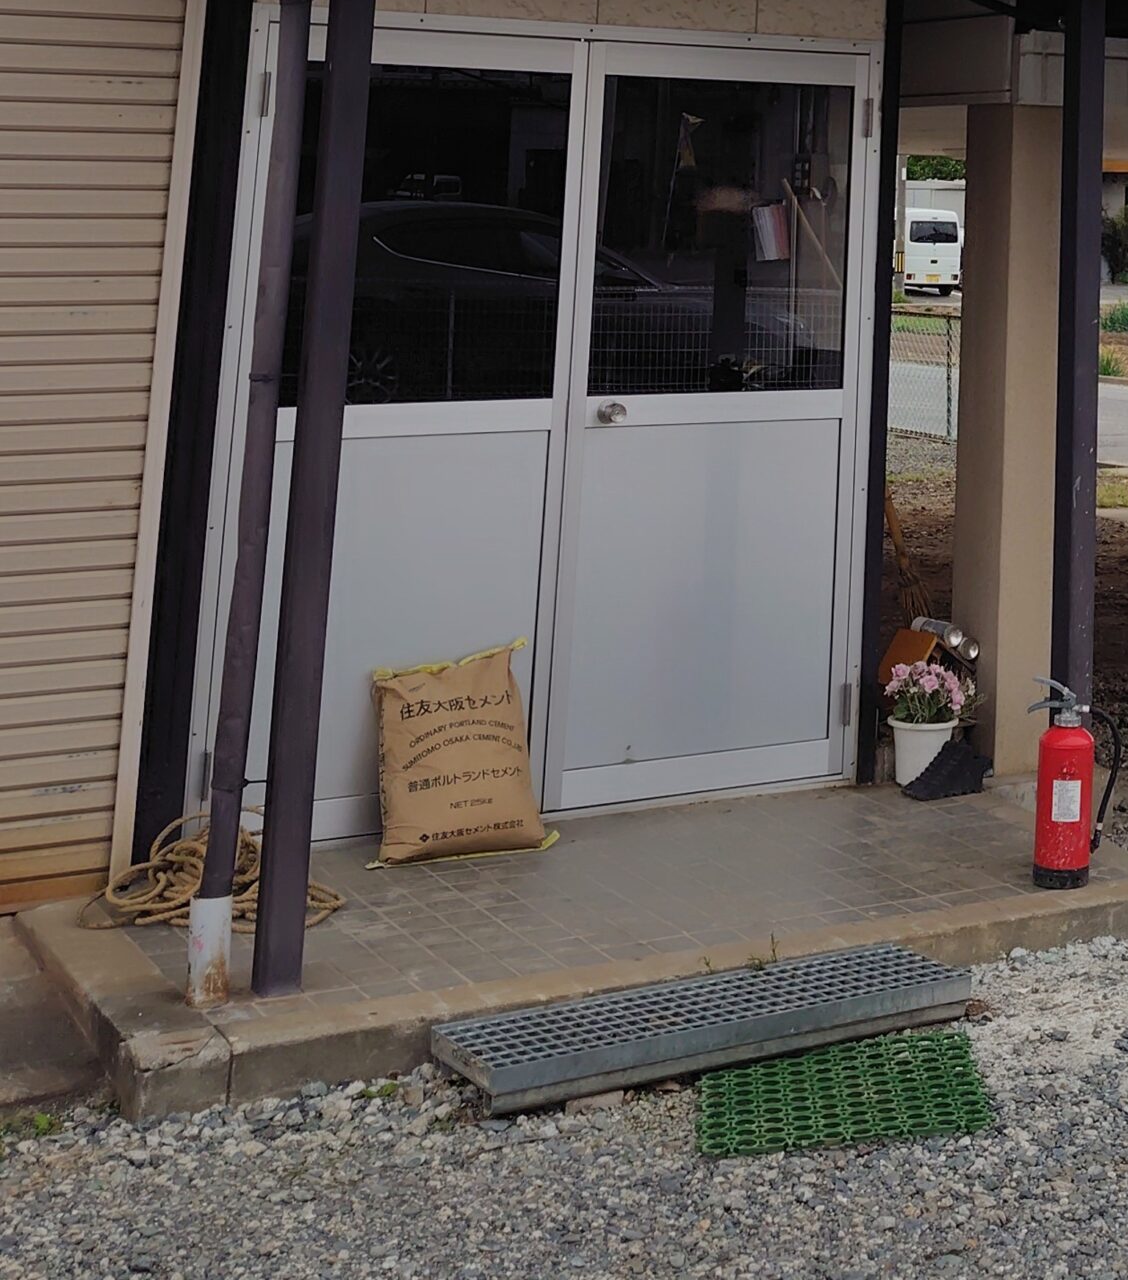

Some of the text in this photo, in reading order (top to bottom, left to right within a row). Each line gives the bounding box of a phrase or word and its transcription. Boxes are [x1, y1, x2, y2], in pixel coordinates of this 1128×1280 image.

[400, 689, 512, 721] 住友大阪セメント
[409, 719, 515, 748] ORDINARY PORTLAND CEMENT
[402, 742, 442, 772] SUMITOMO
[443, 734, 470, 747] OSAKA
[472, 733, 501, 743] CEMENT
[449, 800, 469, 810] NET
[431, 819, 524, 841] 住友大阪セメント株式会社
